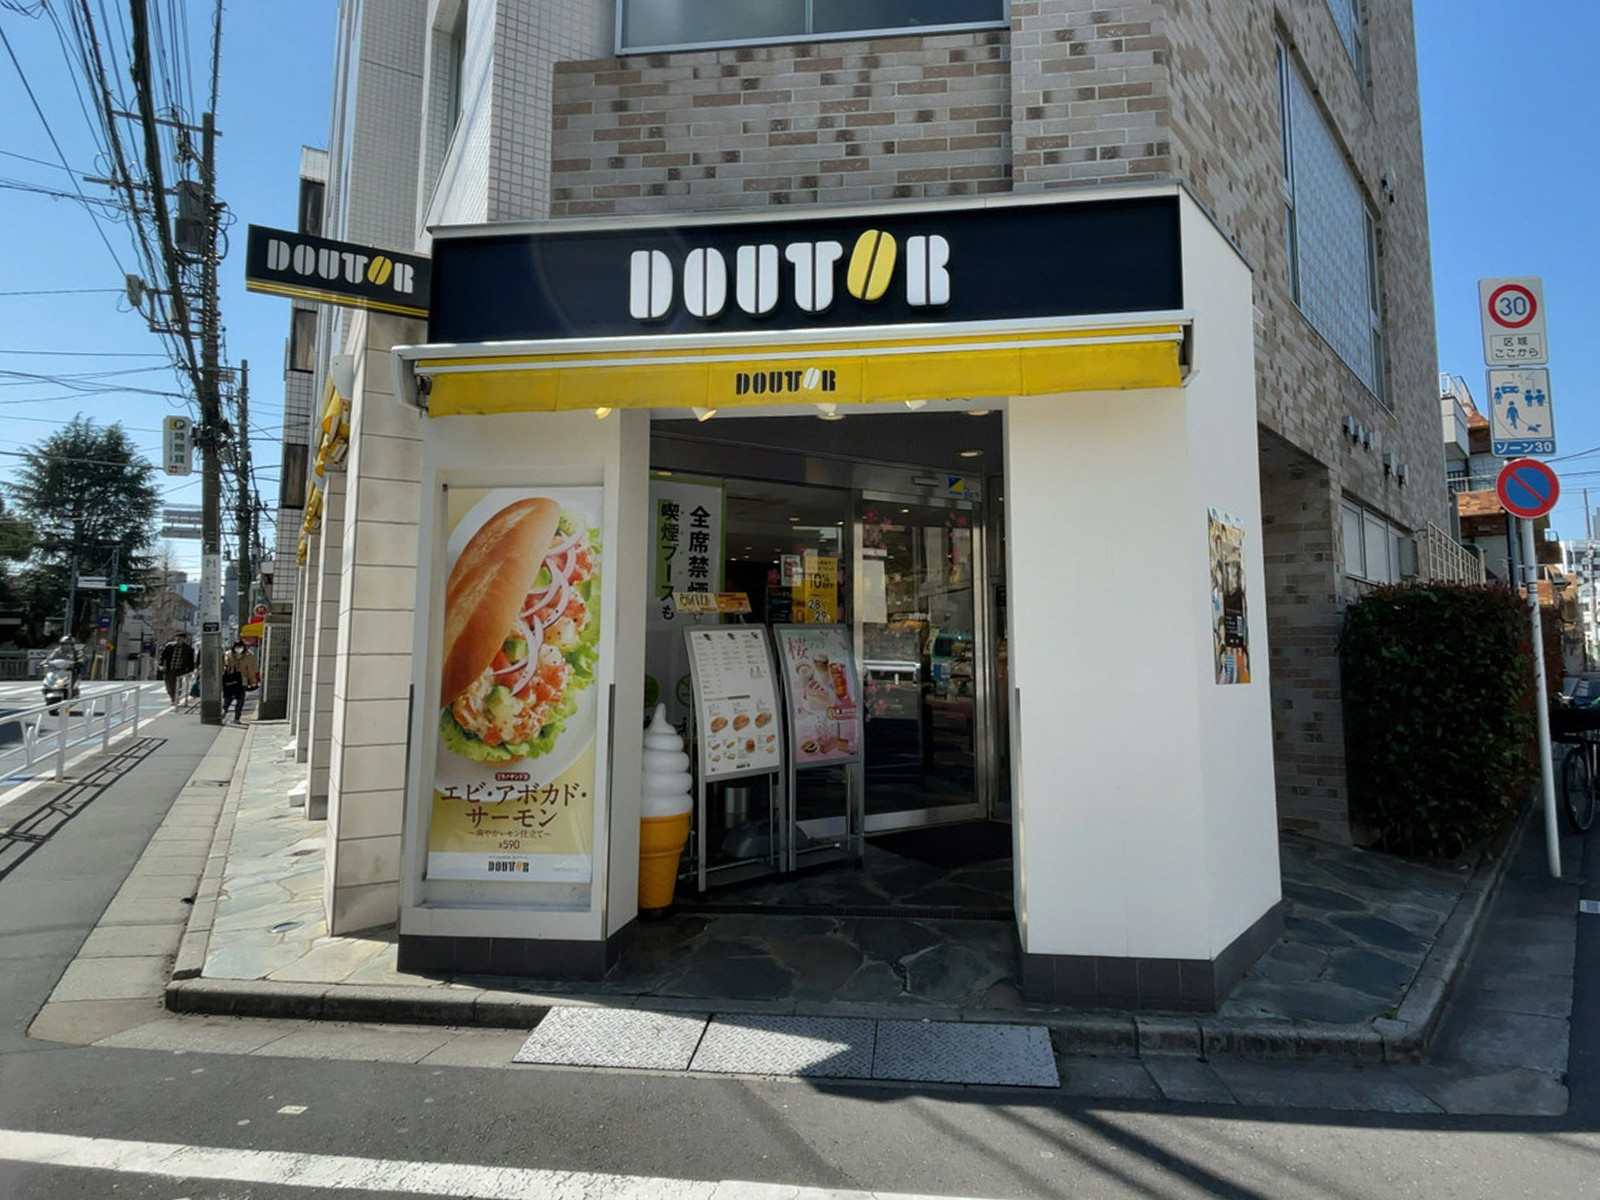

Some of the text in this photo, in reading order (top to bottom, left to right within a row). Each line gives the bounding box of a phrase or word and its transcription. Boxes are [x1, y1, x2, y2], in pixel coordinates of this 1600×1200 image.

[267, 239, 414, 294] DOUTOR
[630, 229, 950, 319] DOUTOR
[1500, 296, 1527, 316] 30
[1495, 346, 1539, 358] ここから
[736, 367, 836, 395] DOUTOR
[440, 781, 588, 807] エビ・アボカド・
[465, 806, 558, 829] サーモン
[488, 861, 530, 873] DOUTOR
